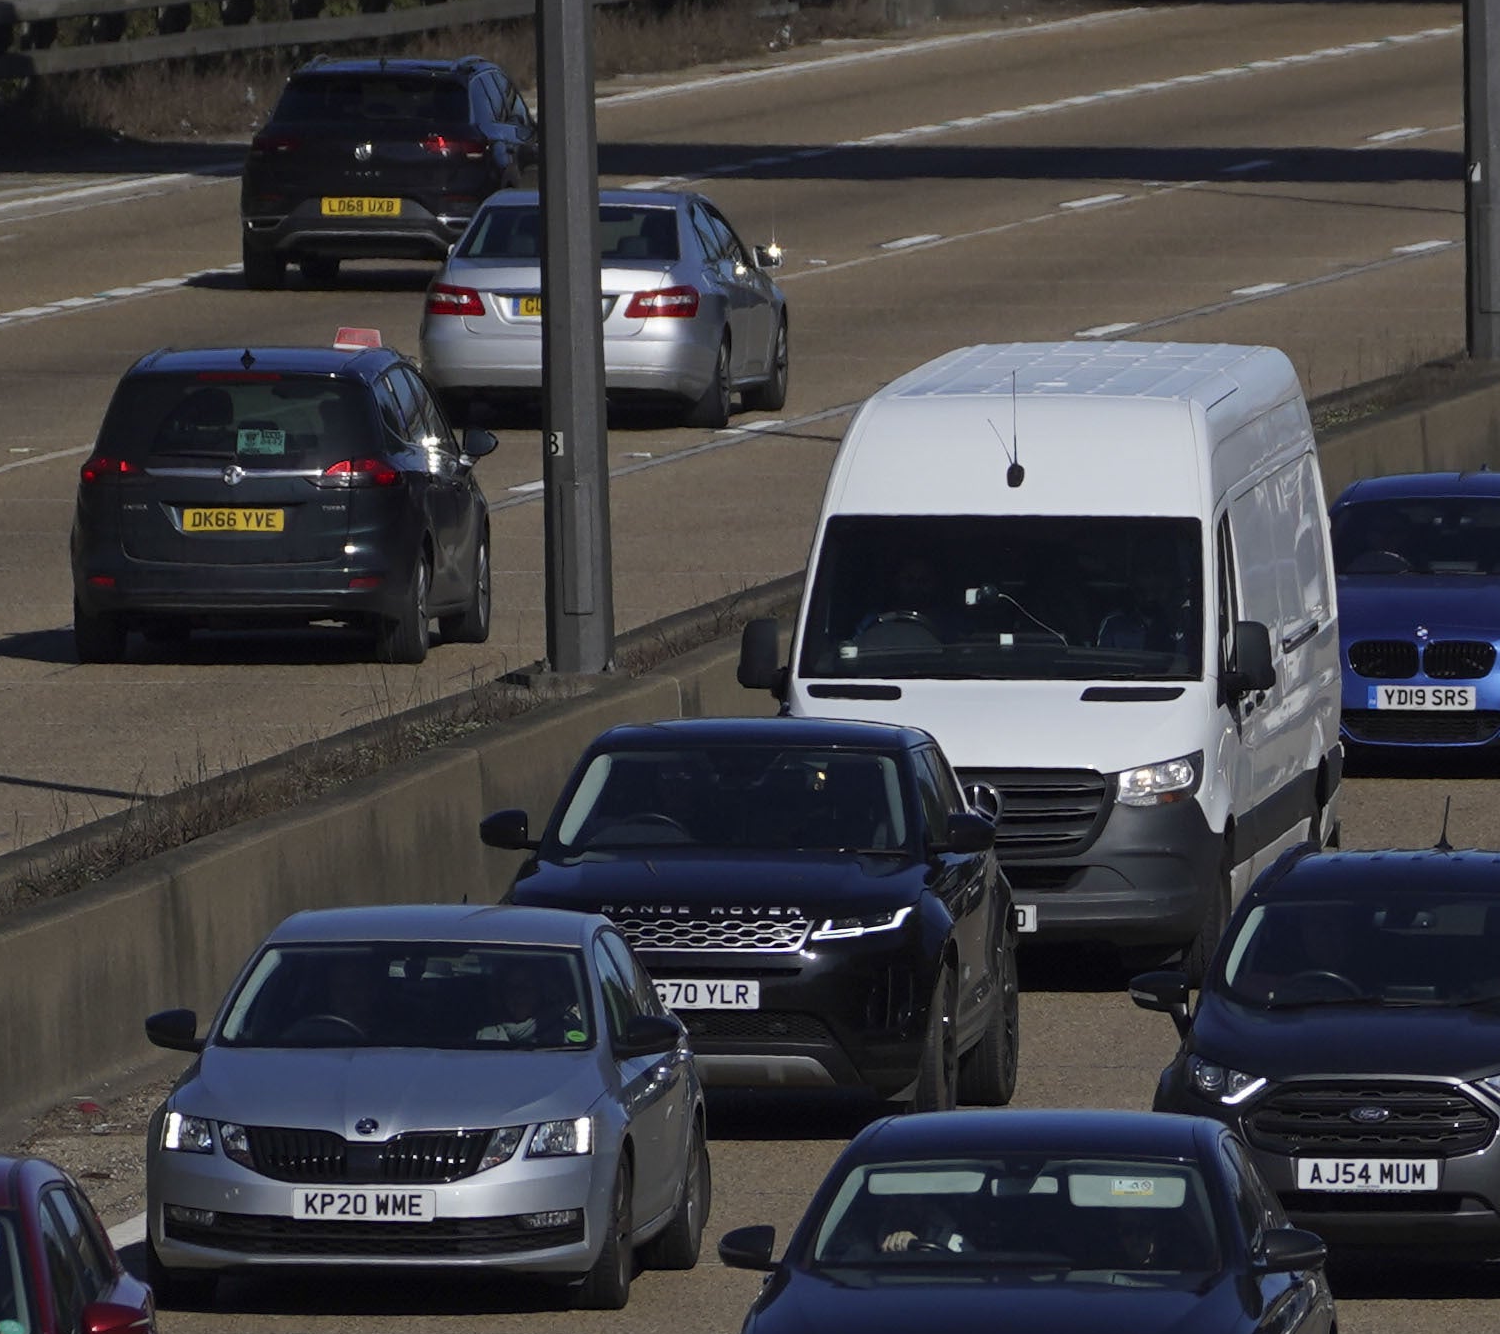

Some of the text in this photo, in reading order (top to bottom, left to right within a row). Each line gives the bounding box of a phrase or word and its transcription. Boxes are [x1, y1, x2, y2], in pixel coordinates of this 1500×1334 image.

[191, 512, 276, 528] DK66 YVE
[1384, 688, 1469, 706] YD19 SRS
[601, 904, 801, 916] RANGE ROVER
[706, 983, 749, 1004] YLR
[1309, 1162, 1426, 1185] AJ54 MUM
[304, 1193, 422, 1215] KP20 WME
